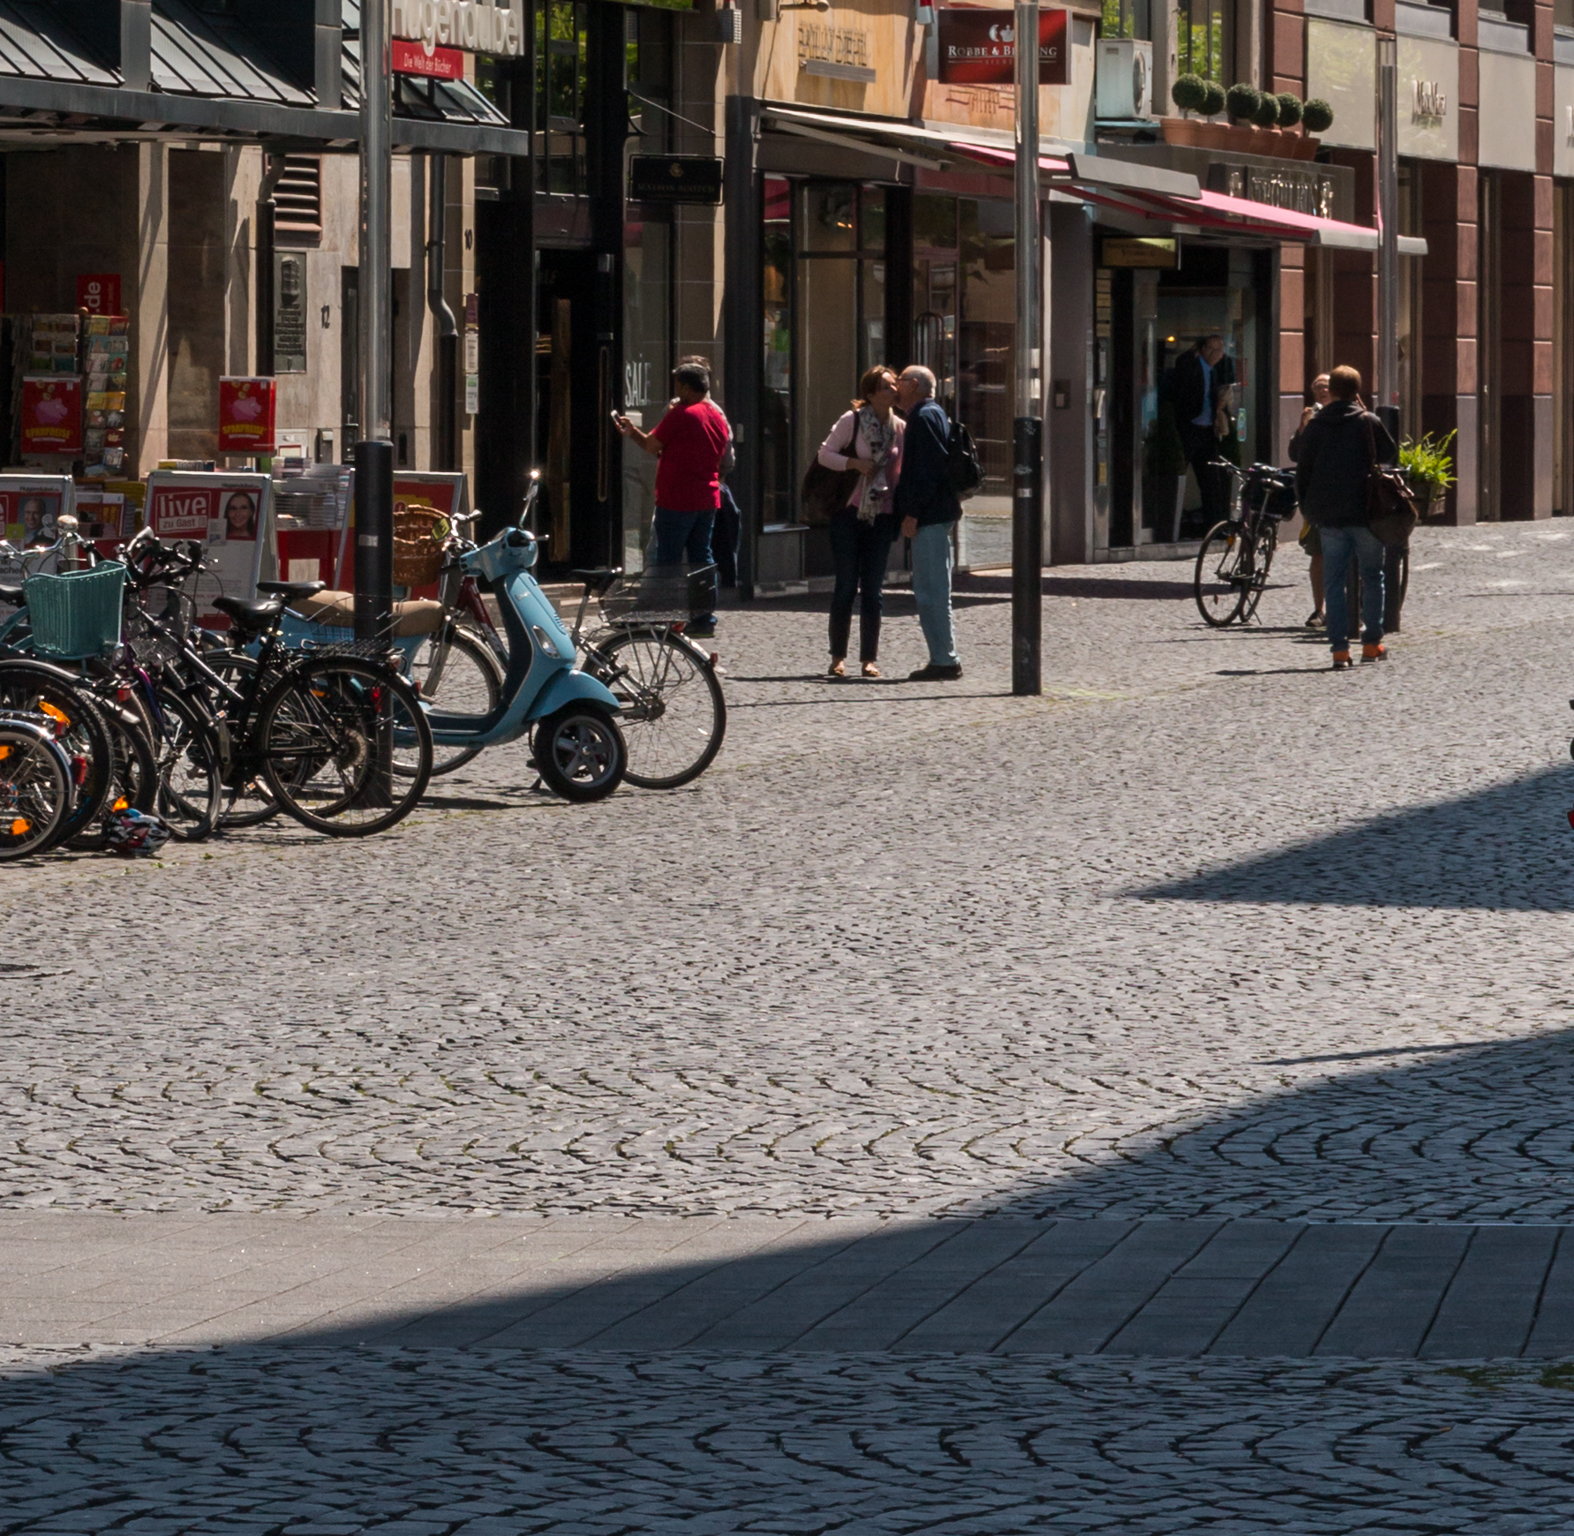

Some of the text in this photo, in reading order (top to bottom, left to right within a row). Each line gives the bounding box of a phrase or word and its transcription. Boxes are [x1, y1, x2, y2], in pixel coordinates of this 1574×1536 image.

[948, 45, 988, 57] ROBBE
[404, 53, 413, 67] Die
[413, 54, 425, 69] Welt
[160, 493, 207, 518] live
[163, 518, 196, 528] zu Gast
